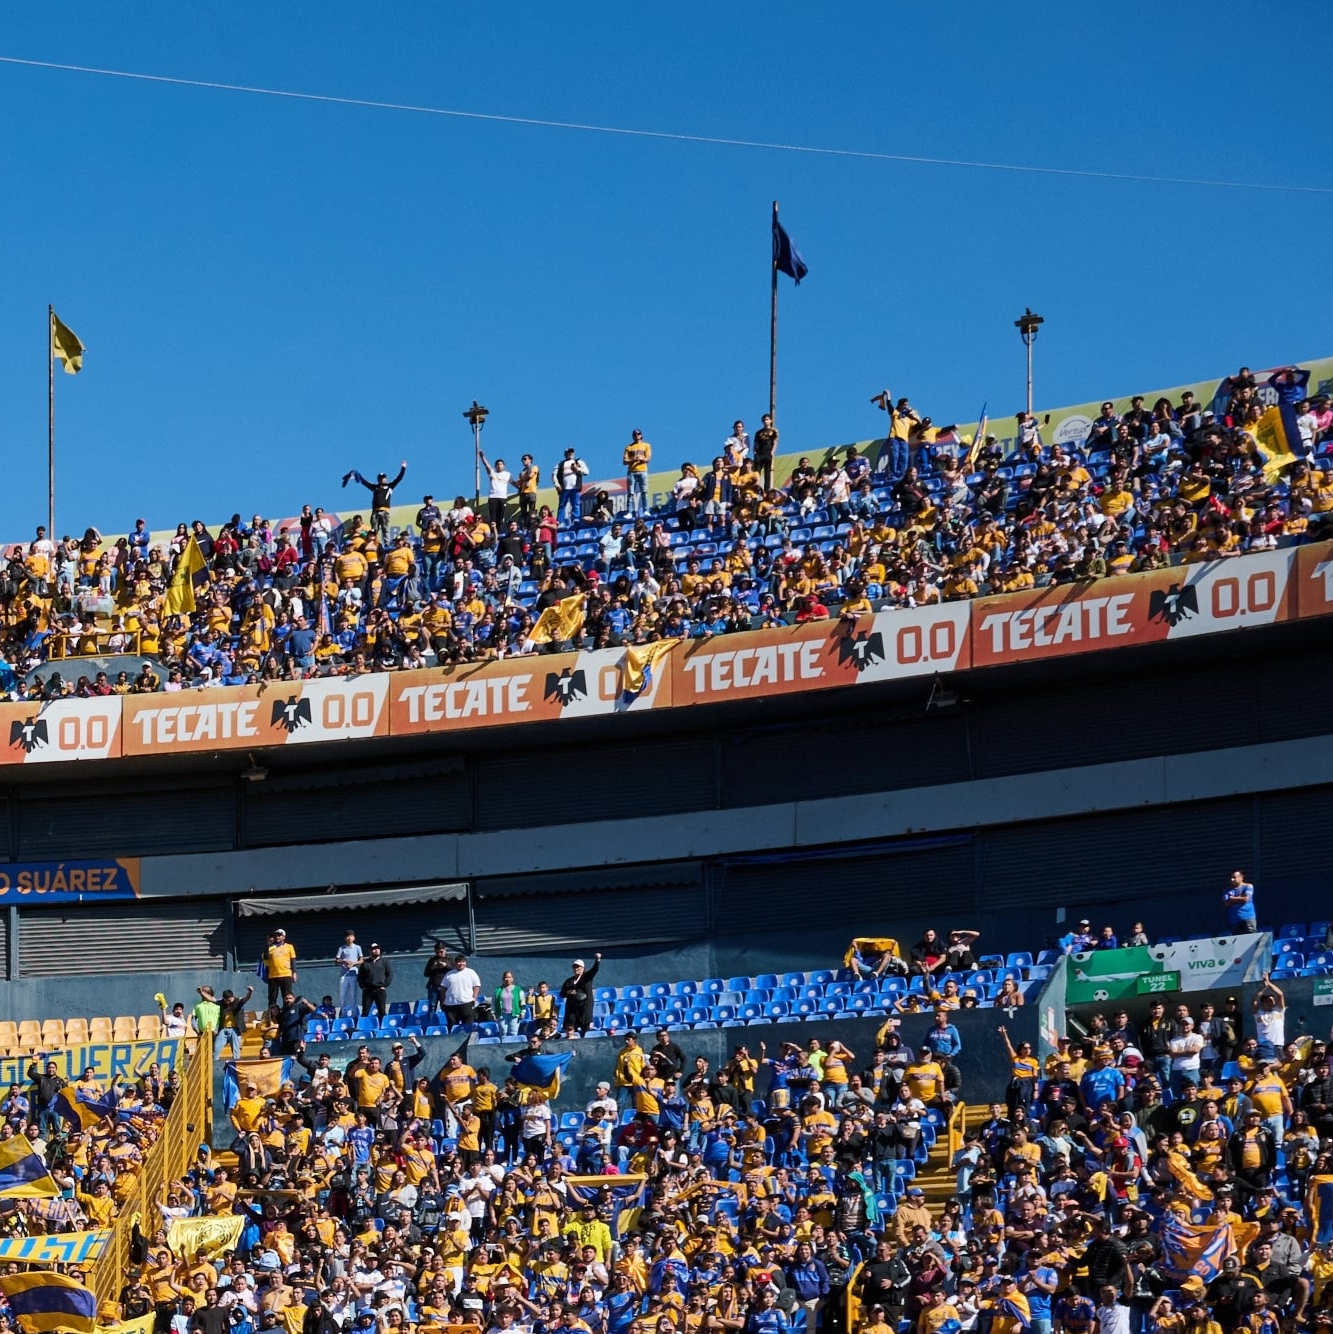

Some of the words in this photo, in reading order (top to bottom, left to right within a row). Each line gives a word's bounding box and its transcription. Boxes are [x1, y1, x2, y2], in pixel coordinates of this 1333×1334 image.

[981, 594, 1134, 652] TECATE
[1212, 571, 1275, 616] 0.0
[685, 639, 825, 693] TECATE
[897, 621, 954, 664] 0.0
[134, 702, 259, 744] TECATE
[322, 692, 373, 727] 0.0
[399, 675, 531, 723] TECATE
[59, 718, 107, 750] 0.0
[17, 863, 117, 894] SUÁREZ
[1142, 975, 1173, 984] TUNEL
[1150, 982, 1166, 991] 22
[42, 1040, 180, 1087] UERZA
